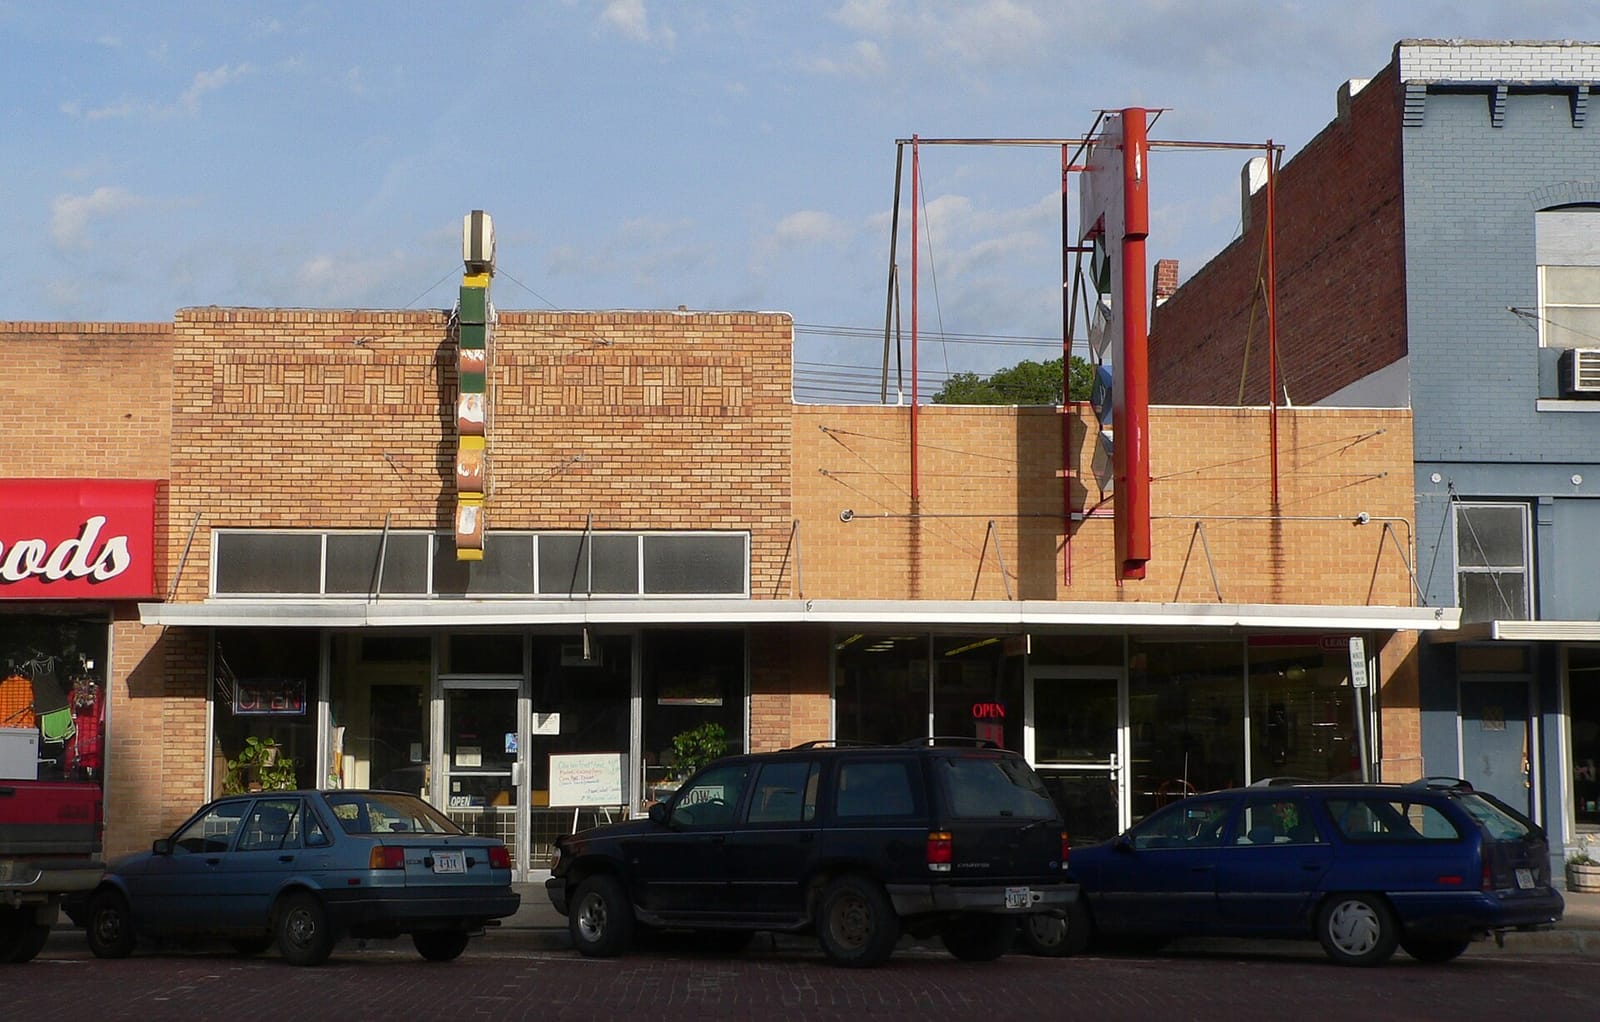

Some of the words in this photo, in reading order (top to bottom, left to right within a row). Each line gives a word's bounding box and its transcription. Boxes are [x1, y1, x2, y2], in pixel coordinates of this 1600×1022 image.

[0, 515, 131, 583] ods
[972, 702, 1005, 718] OPEN
[450, 794, 471, 806] OPEN
